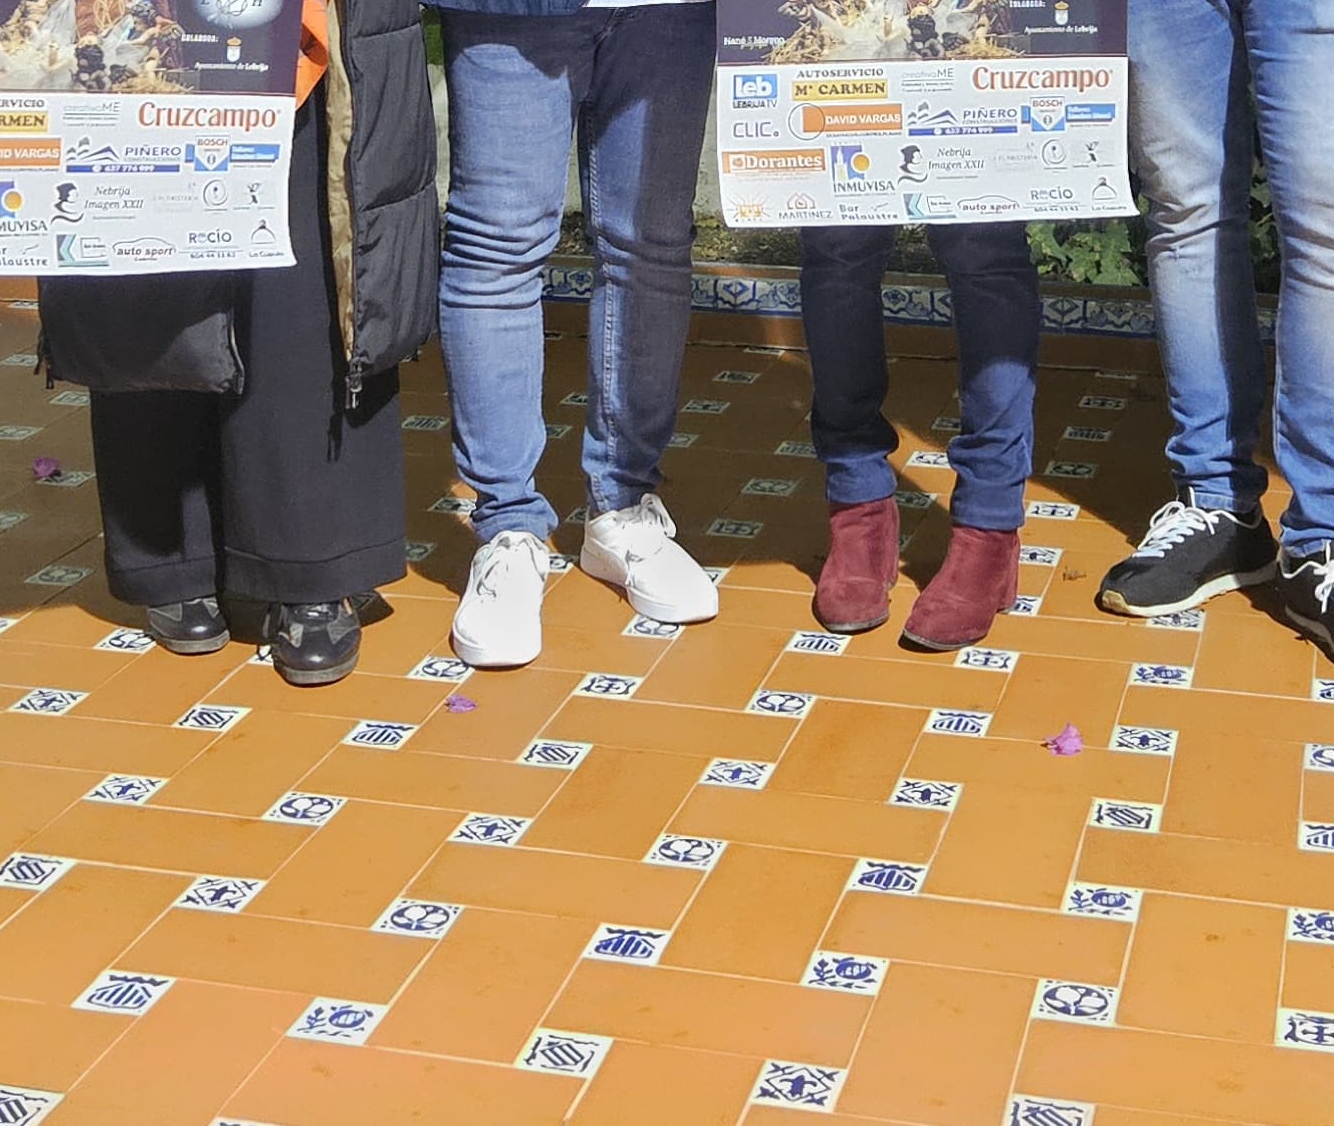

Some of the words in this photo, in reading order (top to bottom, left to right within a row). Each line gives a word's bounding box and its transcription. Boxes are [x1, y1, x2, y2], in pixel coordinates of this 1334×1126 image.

[797, 68, 884, 78] AUTOSERVICIO
[972, 66, 1110, 92] Cruzcampo
[735, 77, 773, 97] leb
[818, 82, 885, 95] CARMEN
[732, 100, 766, 109] LEBRIJA
[766, 100, 778, 108] TV
[1032, 99, 1062, 107] BOSCH
[138, 102, 276, 131] Cruzcampo
[963, 107, 1018, 119] PIÑERO
[826, 116, 857, 124] DAVID
[859, 114, 901, 123] VARGAS
[197, 138, 228, 146] BOSCH
[13, 148, 60, 159] VARGAS
[124, 144, 182, 156] PIÑERO
[937, 148, 971, 158] Nebrija
[746, 155, 822, 169] Dorantes
[928, 160, 962, 171] Imagen
[93, 186, 131, 196] Nebrija
[84, 200, 120, 211] Imagen
[839, 204, 859, 212] Bar
[962, 203, 987, 211] auto
[990, 202, 1016, 212] sport
[778, 211, 832, 220] MARTINEZ
[117, 247, 142, 256] auto
[145, 247, 173, 257] sport
